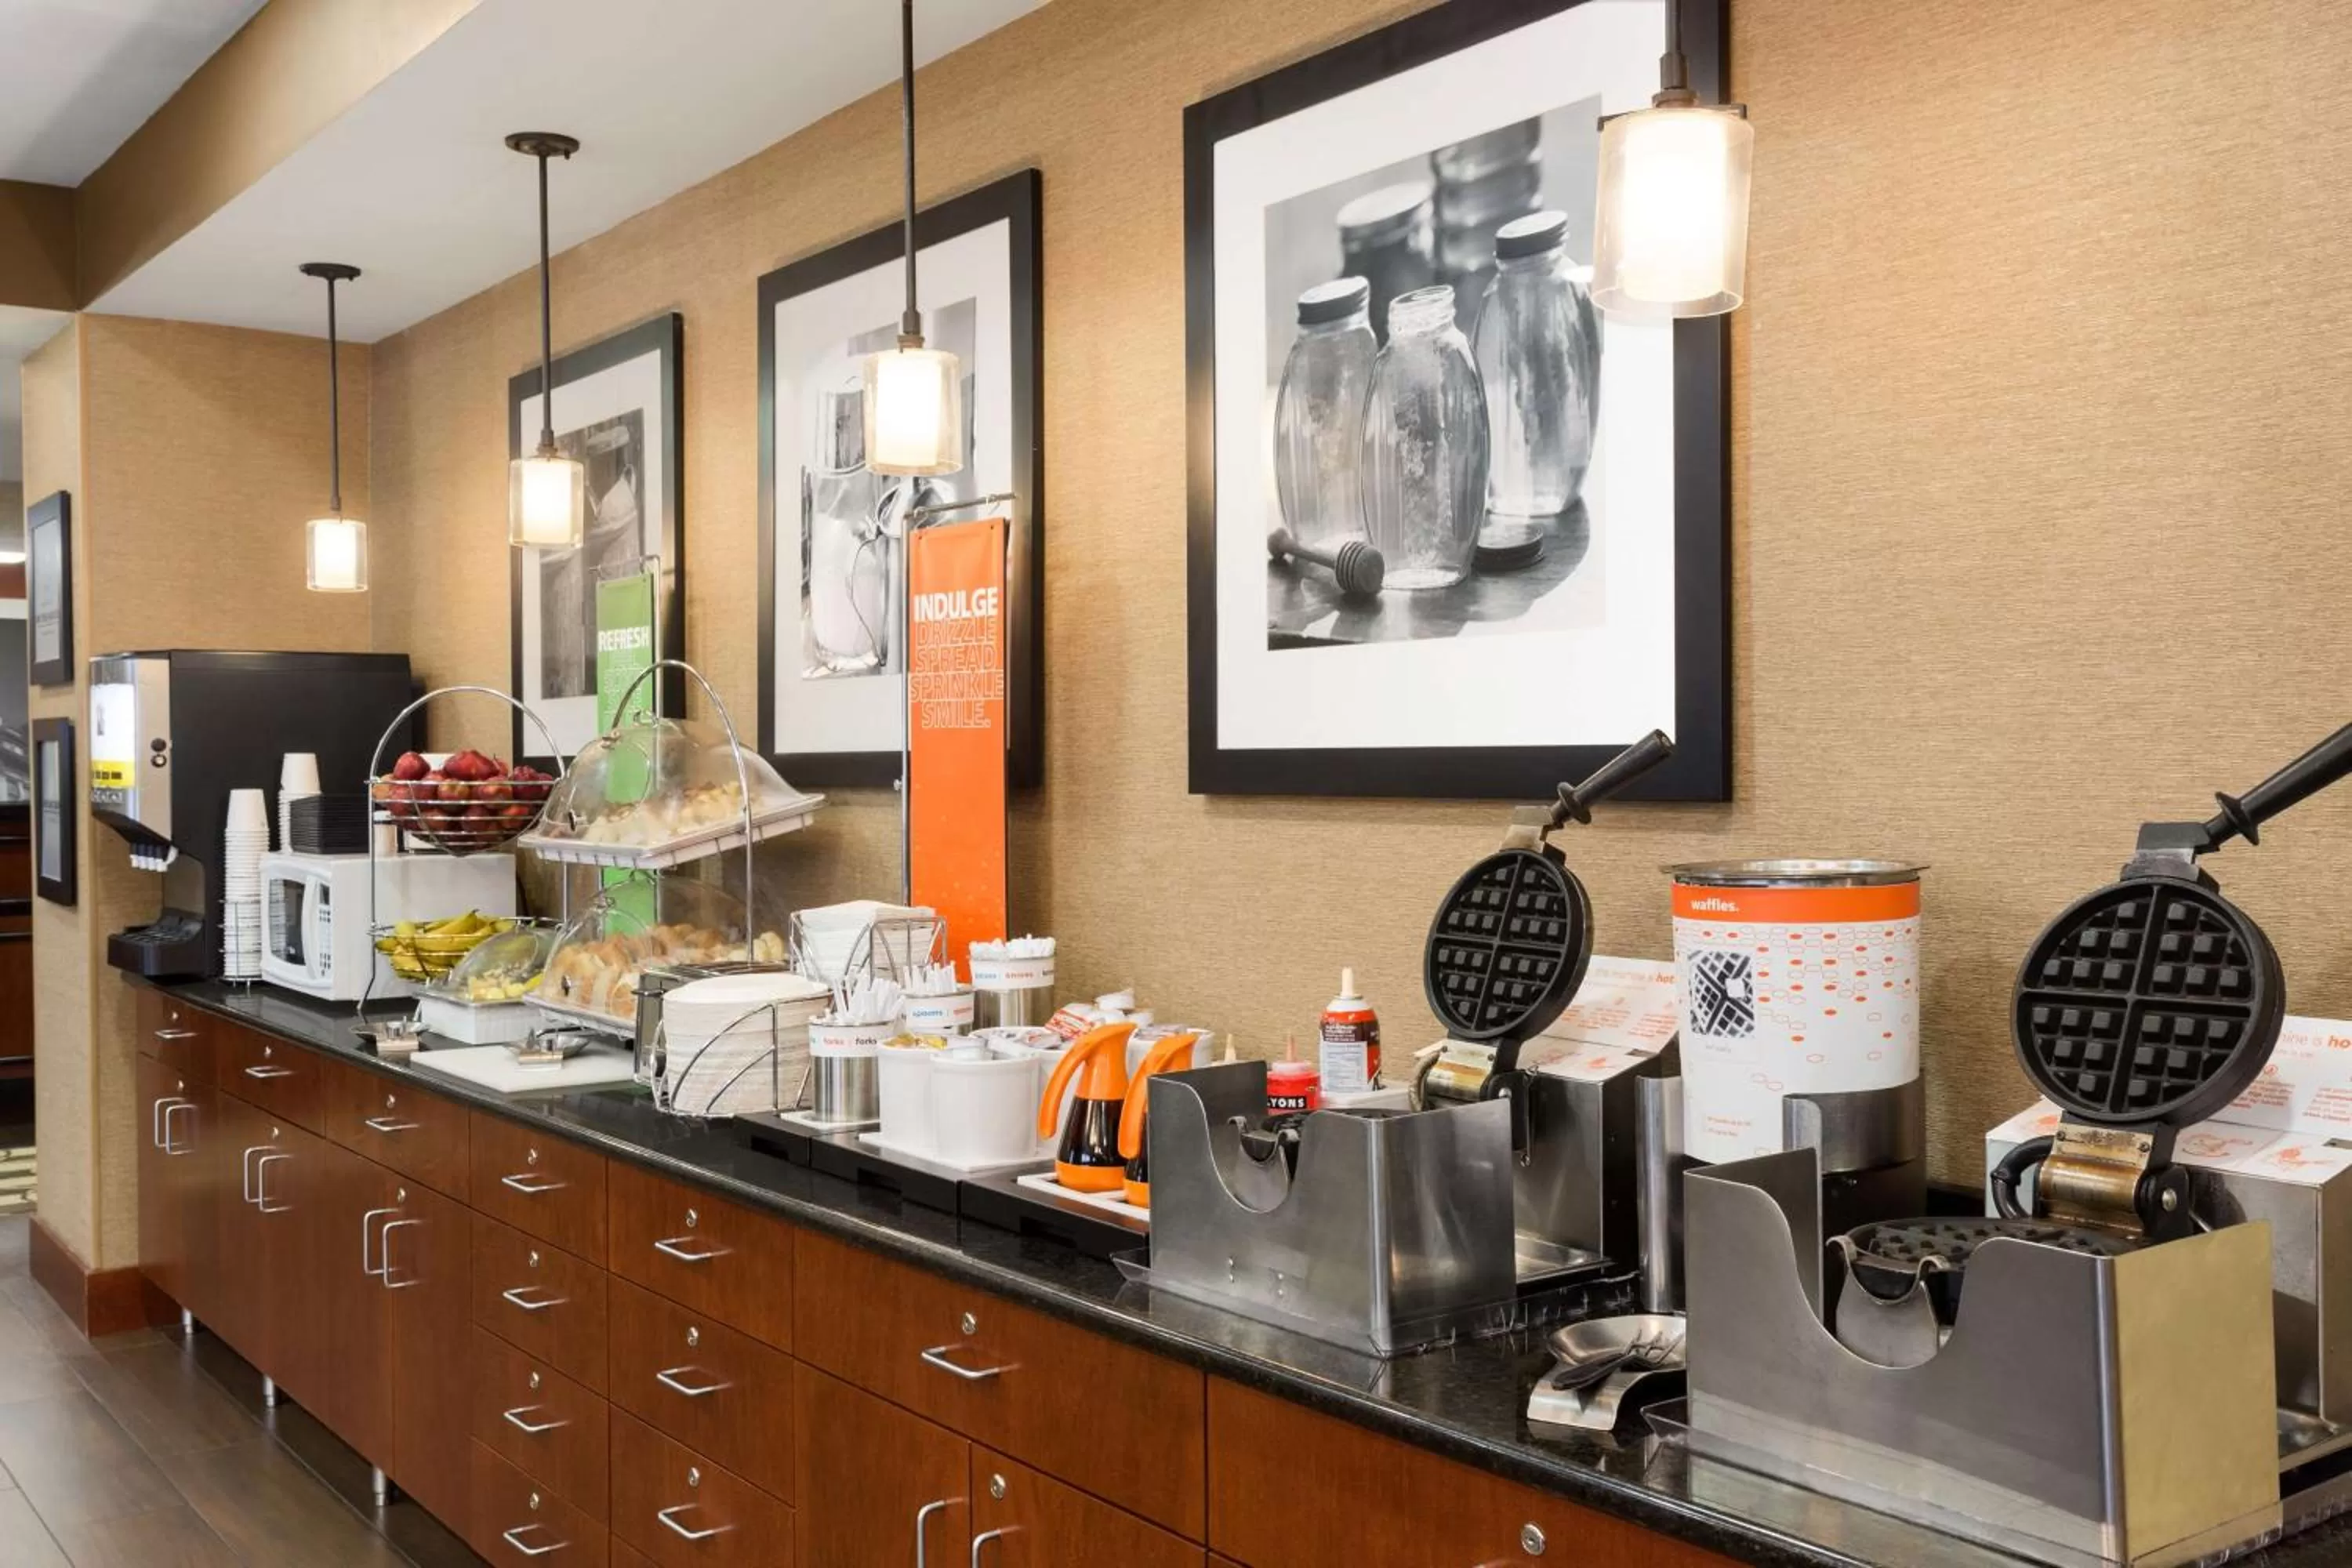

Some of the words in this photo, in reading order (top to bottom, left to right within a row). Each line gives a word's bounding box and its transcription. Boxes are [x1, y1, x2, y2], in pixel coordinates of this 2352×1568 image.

[913, 586, 998, 622] INDULGE
[598, 626, 649, 652] REFRESH
[916, 615, 997, 648] DRIZZLE
[916, 642, 997, 673] SPREAD
[909, 672, 1004, 702] SPRINKLE
[1690, 897, 1740, 913] waffles.
[855, 1036, 878, 1045] forks
[1268, 1098, 1305, 1109] YONS
